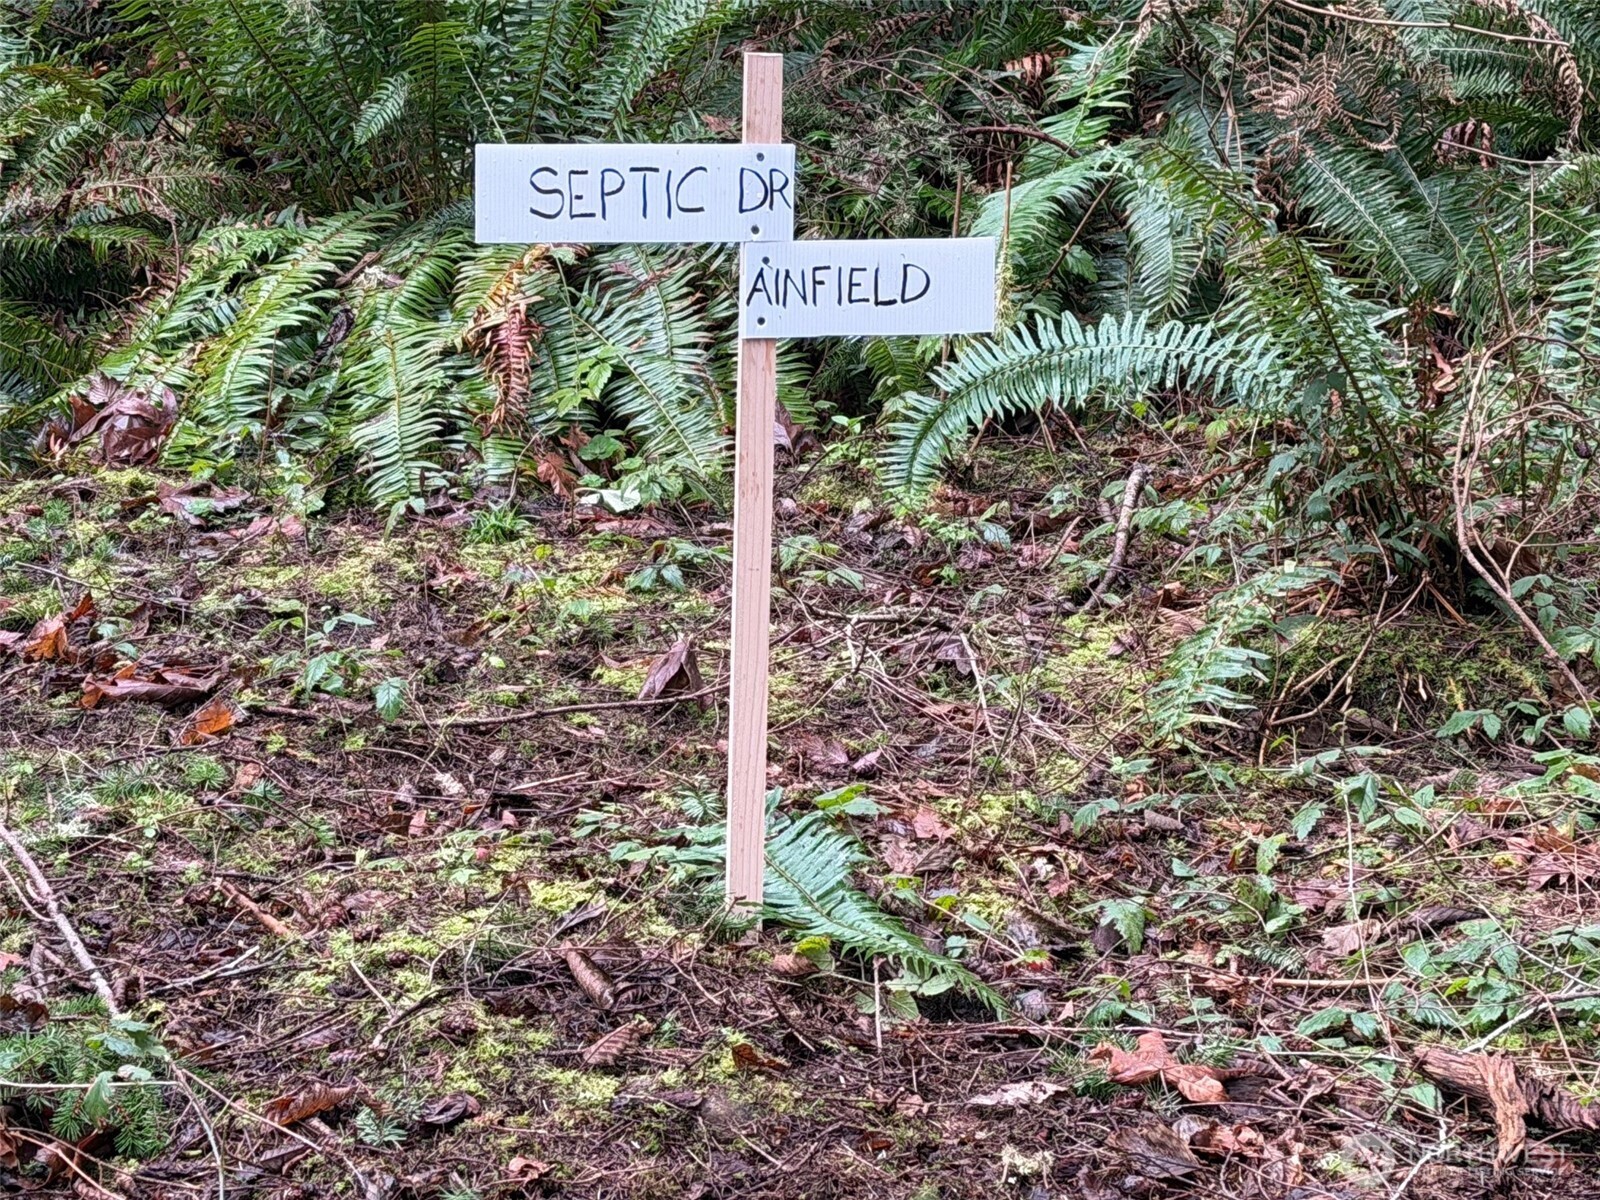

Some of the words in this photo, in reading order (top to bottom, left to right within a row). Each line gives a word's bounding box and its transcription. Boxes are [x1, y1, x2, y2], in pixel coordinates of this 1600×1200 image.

[529, 166, 709, 221] SEPTIC
[738, 168, 793, 214] DR
[746, 263, 931, 308] AINFIELD
